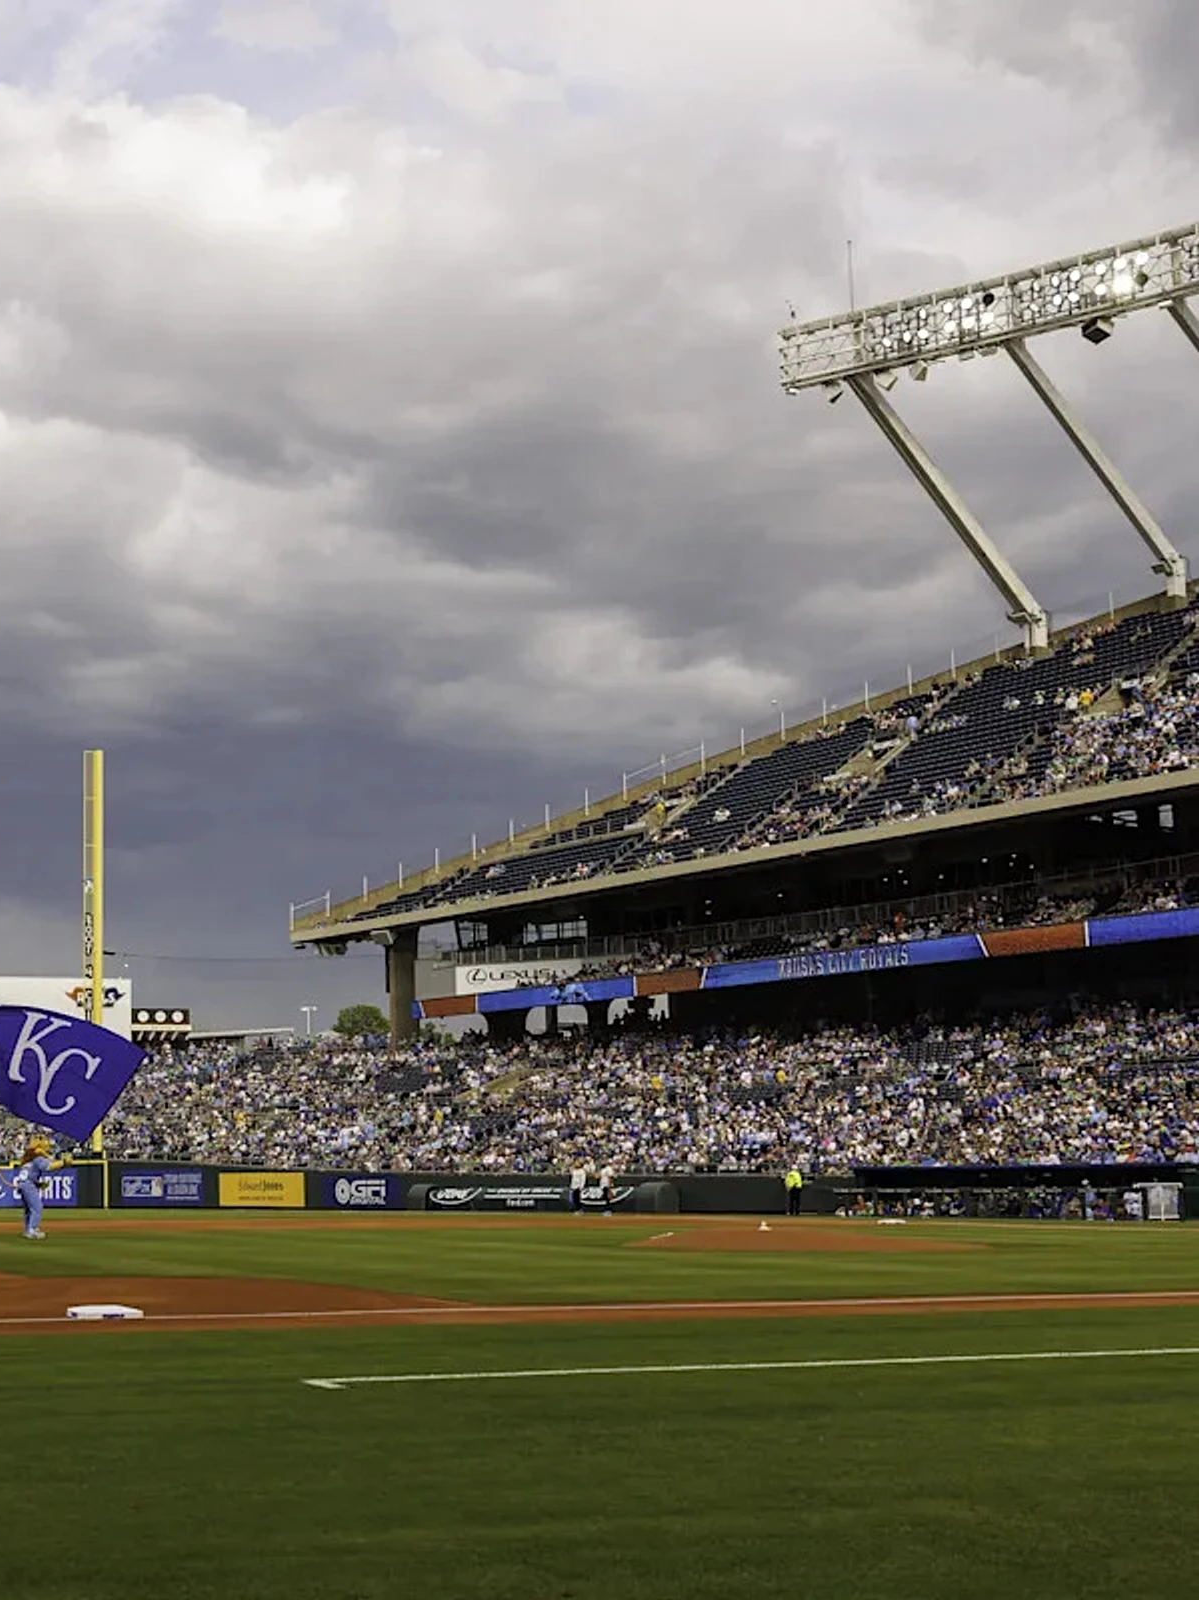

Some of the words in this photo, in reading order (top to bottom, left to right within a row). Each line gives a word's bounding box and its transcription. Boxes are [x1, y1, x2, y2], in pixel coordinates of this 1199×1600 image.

[828, 950, 858, 973] CITY
[860, 945, 908, 971] ROYALS
[7, 1010, 101, 1115] KC
